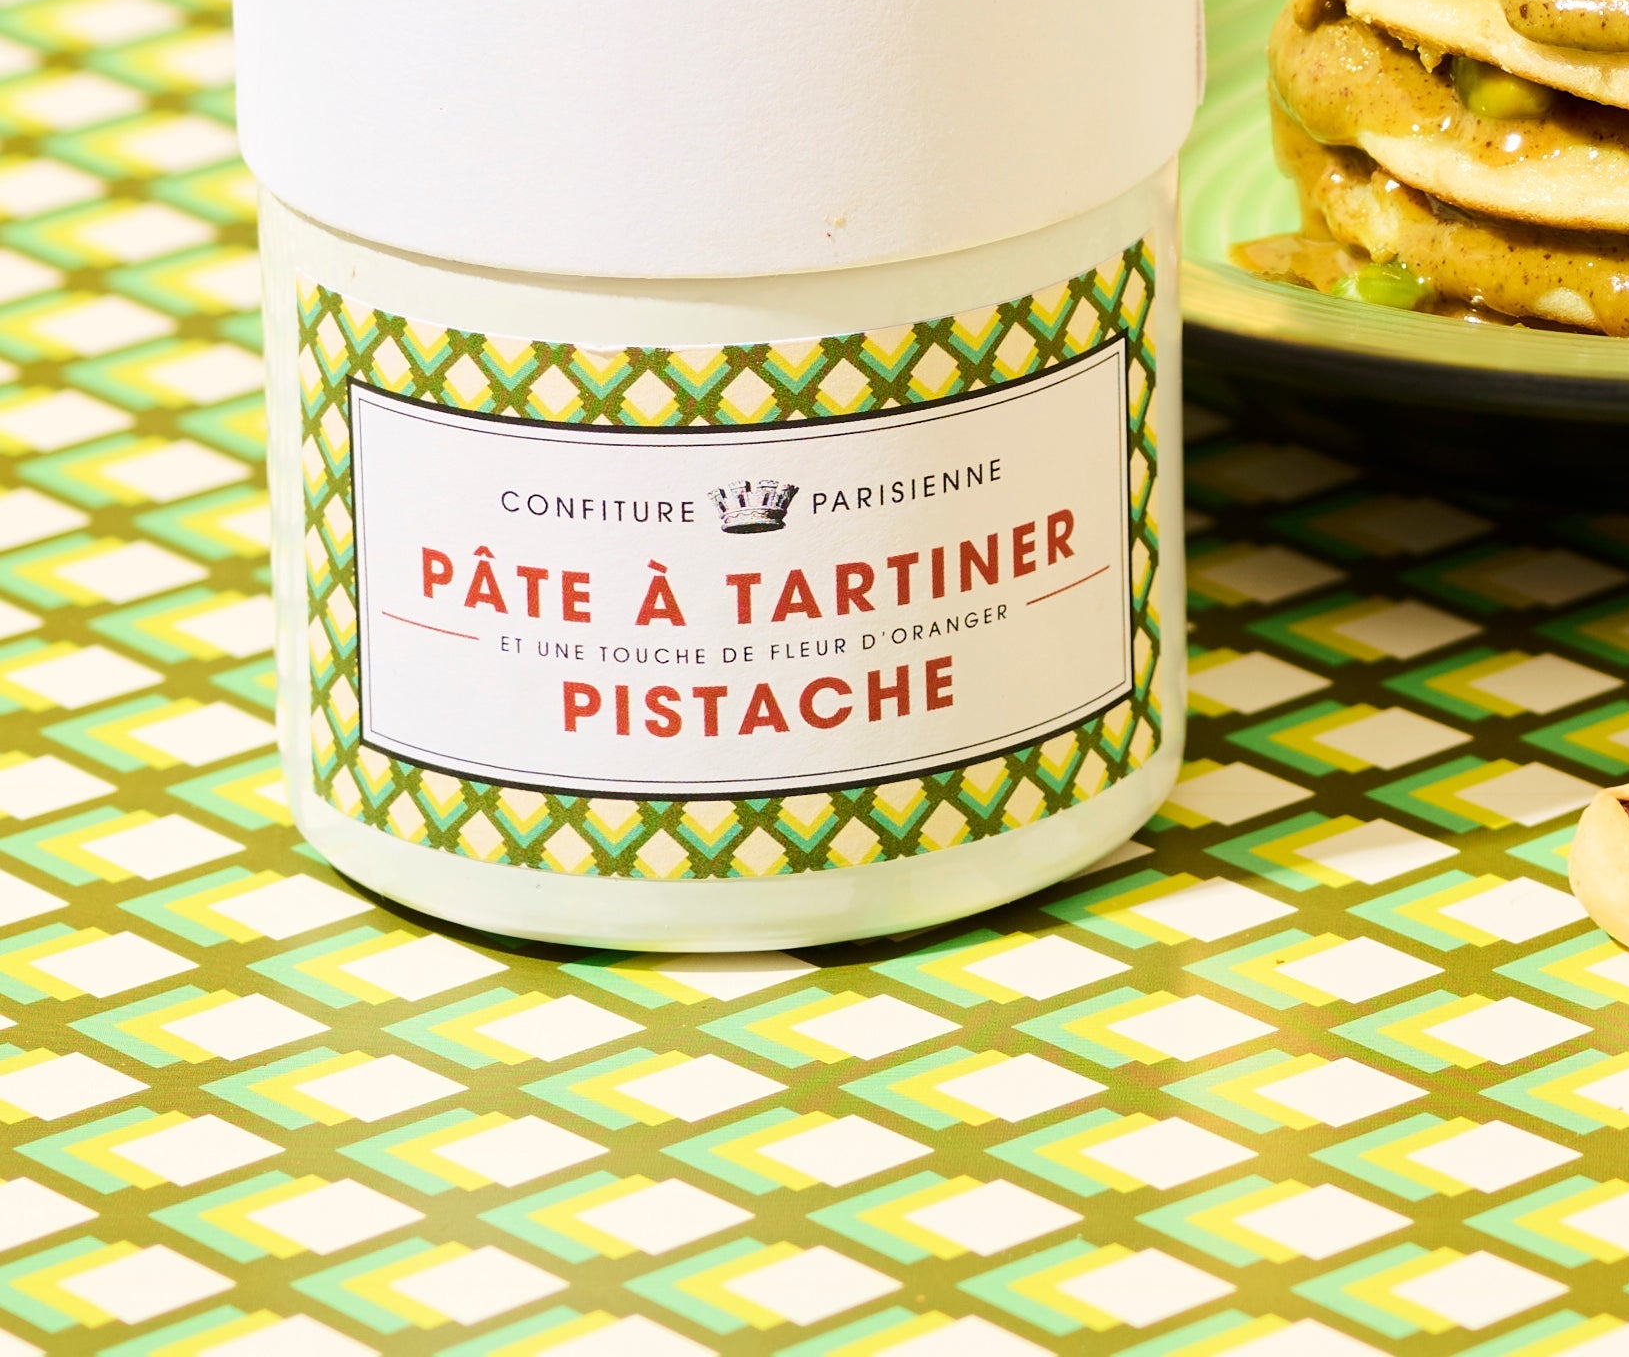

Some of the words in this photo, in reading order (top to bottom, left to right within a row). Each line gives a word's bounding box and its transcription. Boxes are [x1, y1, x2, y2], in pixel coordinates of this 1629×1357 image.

[501, 491, 696, 523] CONFITURE
[812, 458, 1002, 515] PARISIENNE
[420, 545, 592, 623] PÂTE
[636, 560, 686, 627] À
[726, 508, 1076, 625] TARTINER
[501, 637, 524, 653] ET
[538, 641, 586, 661] UNE
[599, 646, 706, 665] TOUCHE
[723, 644, 753, 663] DE
[770, 637, 846, 661] FLEUR
[862, 604, 1009, 651] D'ORANGER
[562, 656, 955, 737] PISTACHE
